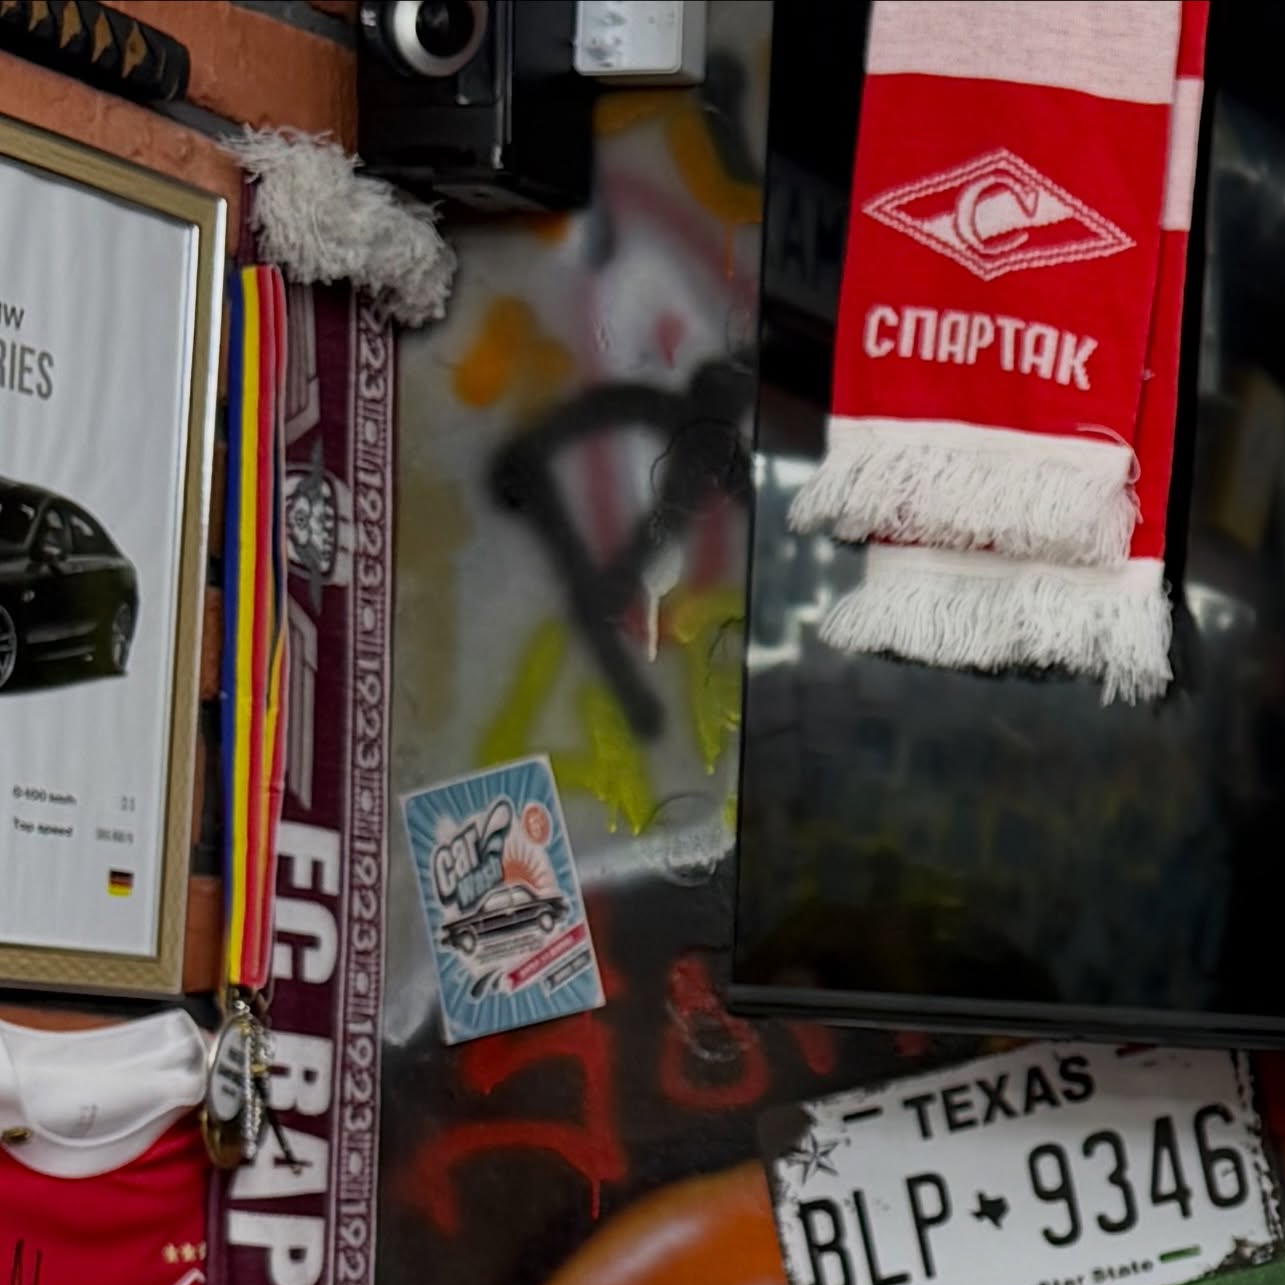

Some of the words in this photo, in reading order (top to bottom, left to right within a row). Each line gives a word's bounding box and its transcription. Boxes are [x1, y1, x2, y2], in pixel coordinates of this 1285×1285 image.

[862, 305, 1098, 390] СПАРТАК
[358, 466, 384, 587] 1923
[357, 658, 382, 770] 1923
[352, 838, 379, 952] 1923
[344, 1019, 374, 1132] 1923
[904, 1055, 1095, 1140] TEXAS
[1027, 1104, 1250, 1248] 9346
[1092, 1259, 1154, 1283] State
